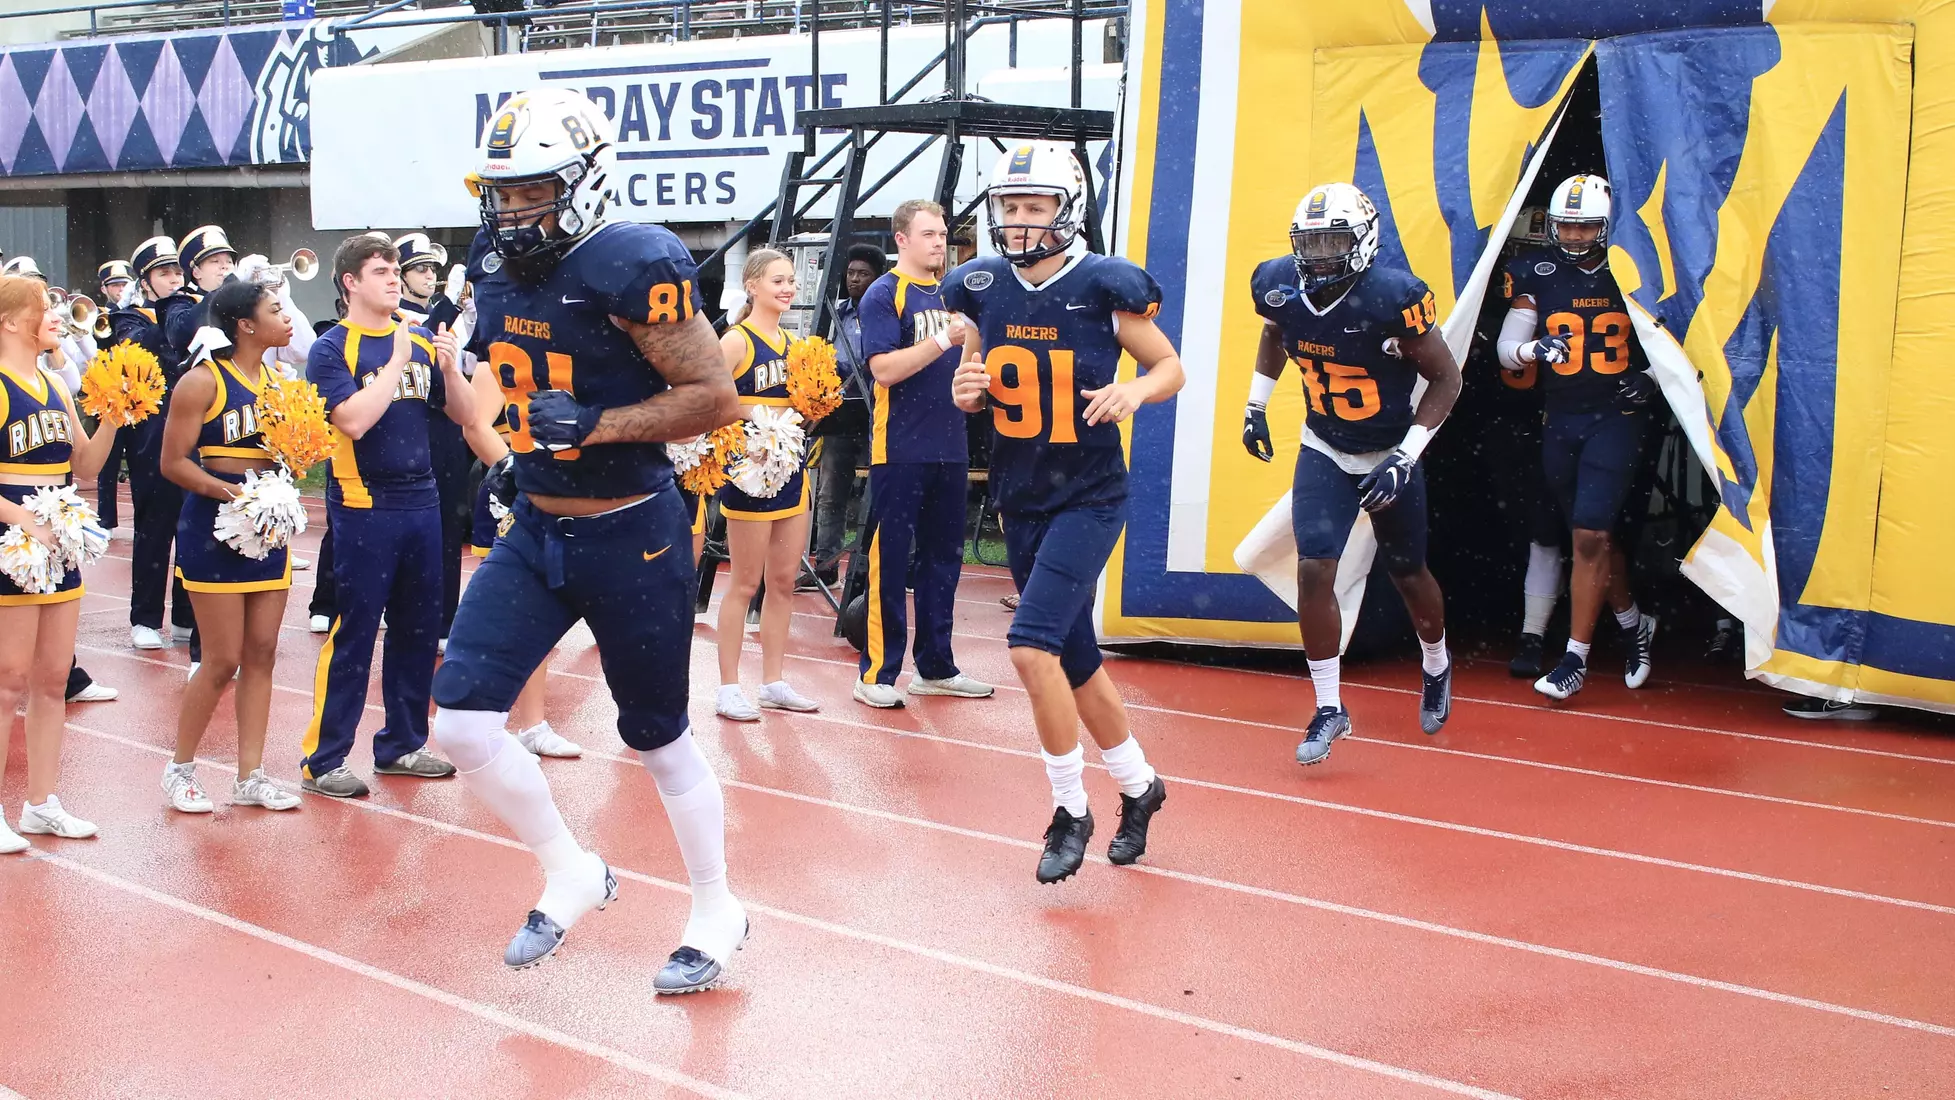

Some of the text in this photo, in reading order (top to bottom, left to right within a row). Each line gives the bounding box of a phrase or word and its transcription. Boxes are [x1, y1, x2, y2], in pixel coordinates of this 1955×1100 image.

[691, 73, 847, 140] STATE
[609, 170, 736, 206] CERS
[647, 279, 694, 324] 81
[1401, 291, 1436, 335] 45
[1573, 297, 1610, 308] RACERS
[504, 314, 551, 340] RACERS
[1005, 324, 1058, 340] RACERS
[1546, 311, 1632, 376] 93
[1297, 339, 1335, 357] RACERS
[754, 358, 788, 393] RAC
[985, 344, 1078, 443] 91
[488, 341, 581, 461] 81
